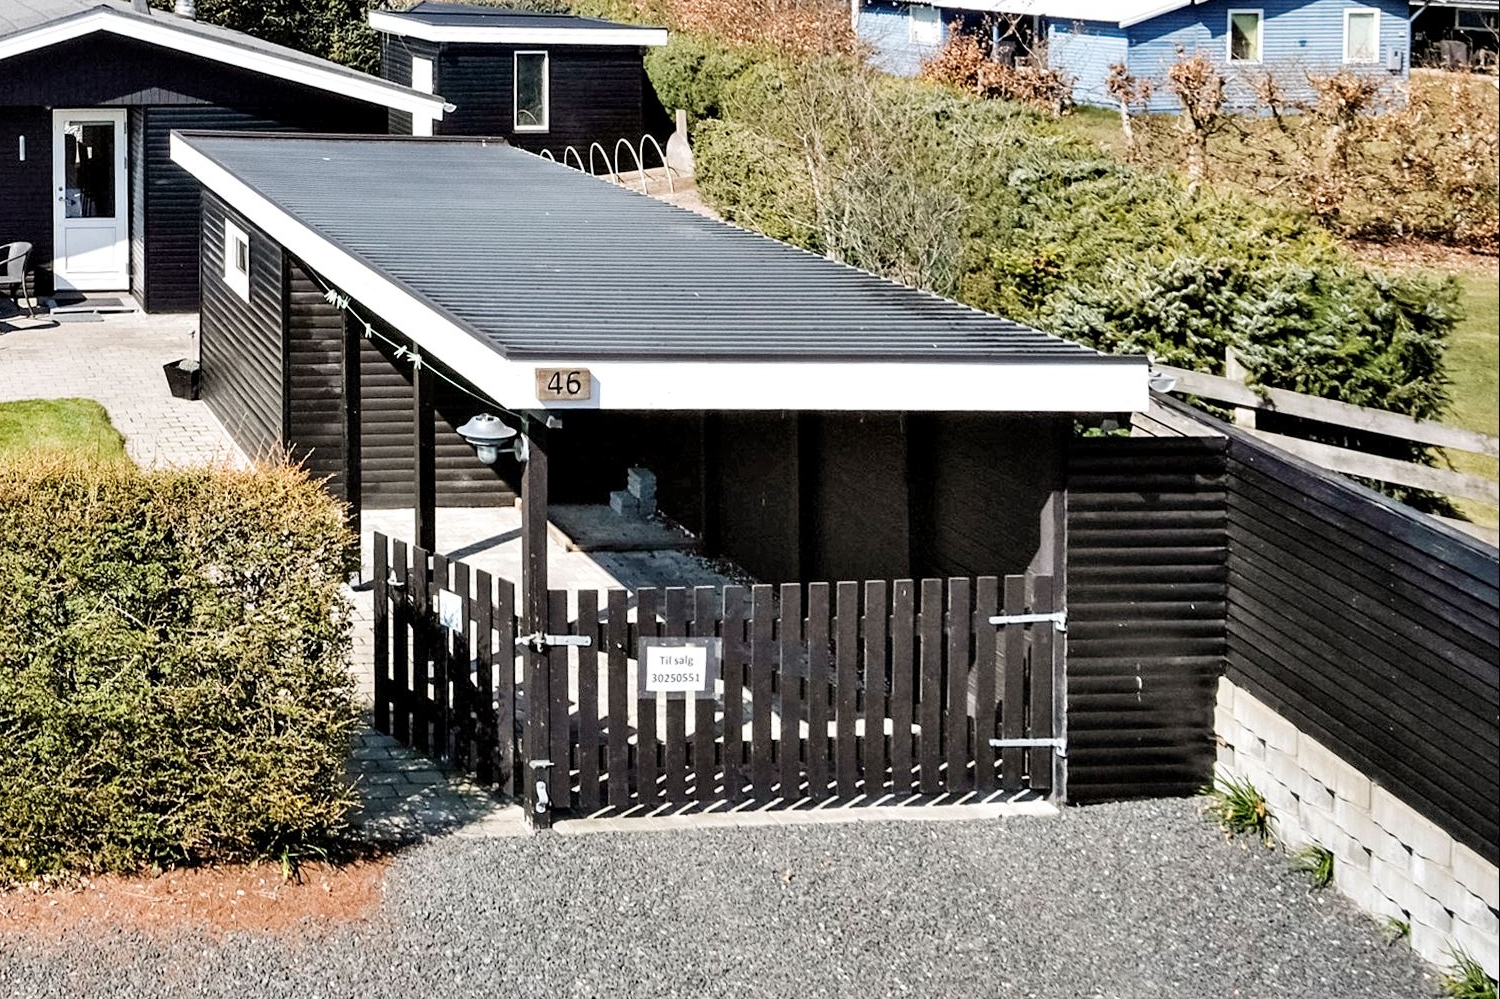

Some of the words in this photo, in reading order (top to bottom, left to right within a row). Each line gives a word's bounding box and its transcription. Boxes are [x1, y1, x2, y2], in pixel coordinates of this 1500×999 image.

[547, 371, 582, 395] 46
[660, 656, 672, 665] Til
[674, 656, 694, 667] salg
[652, 673, 700, 683] 30250551
